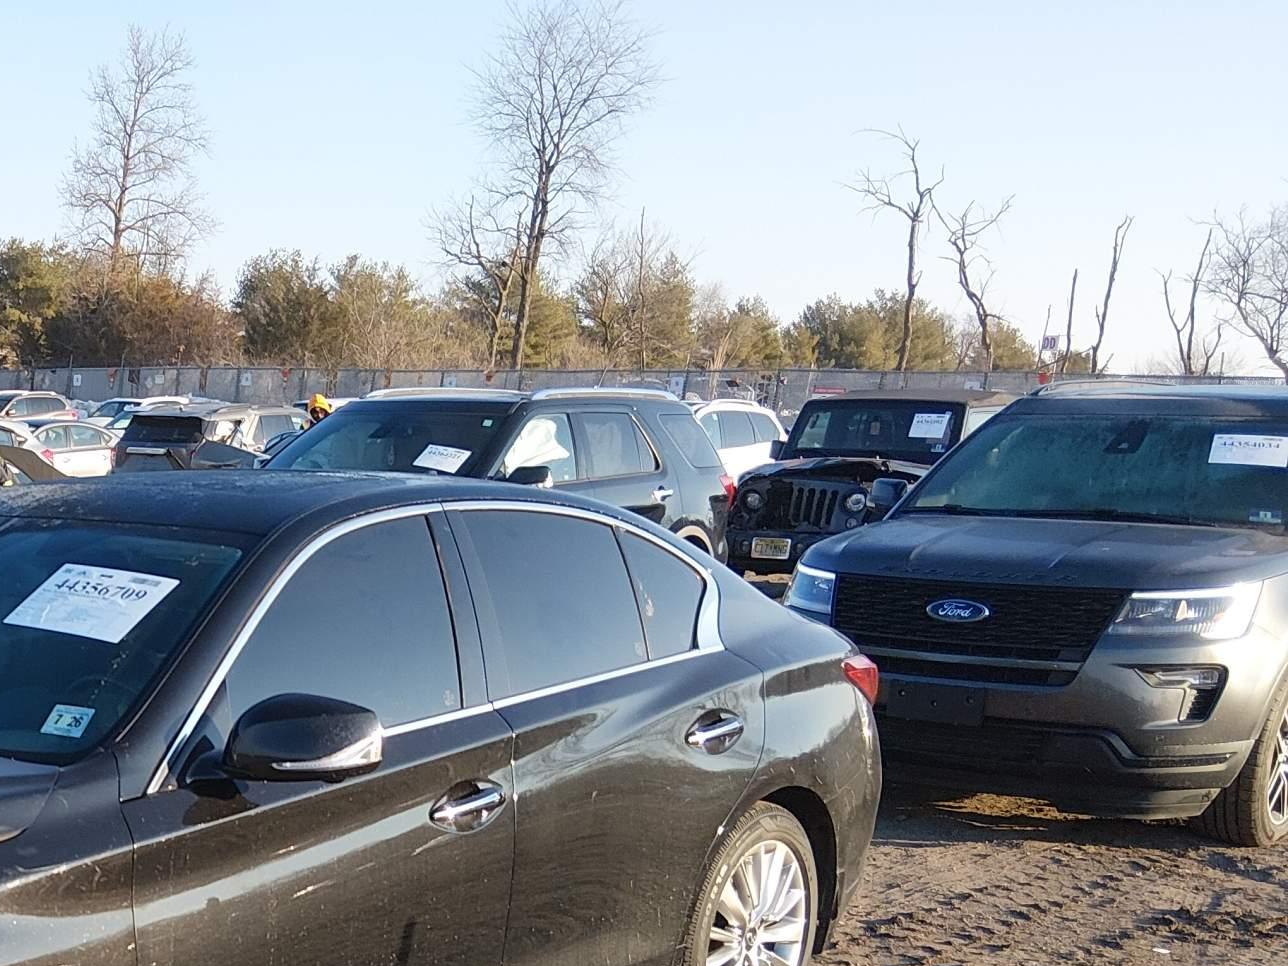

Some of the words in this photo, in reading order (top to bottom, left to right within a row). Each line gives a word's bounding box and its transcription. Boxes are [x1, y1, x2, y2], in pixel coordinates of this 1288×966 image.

[55, 579, 148, 601] 44356709
[938, 602, 972, 618] Ford
[53, 714, 62, 725] 7
[66, 715, 84, 727] 26
